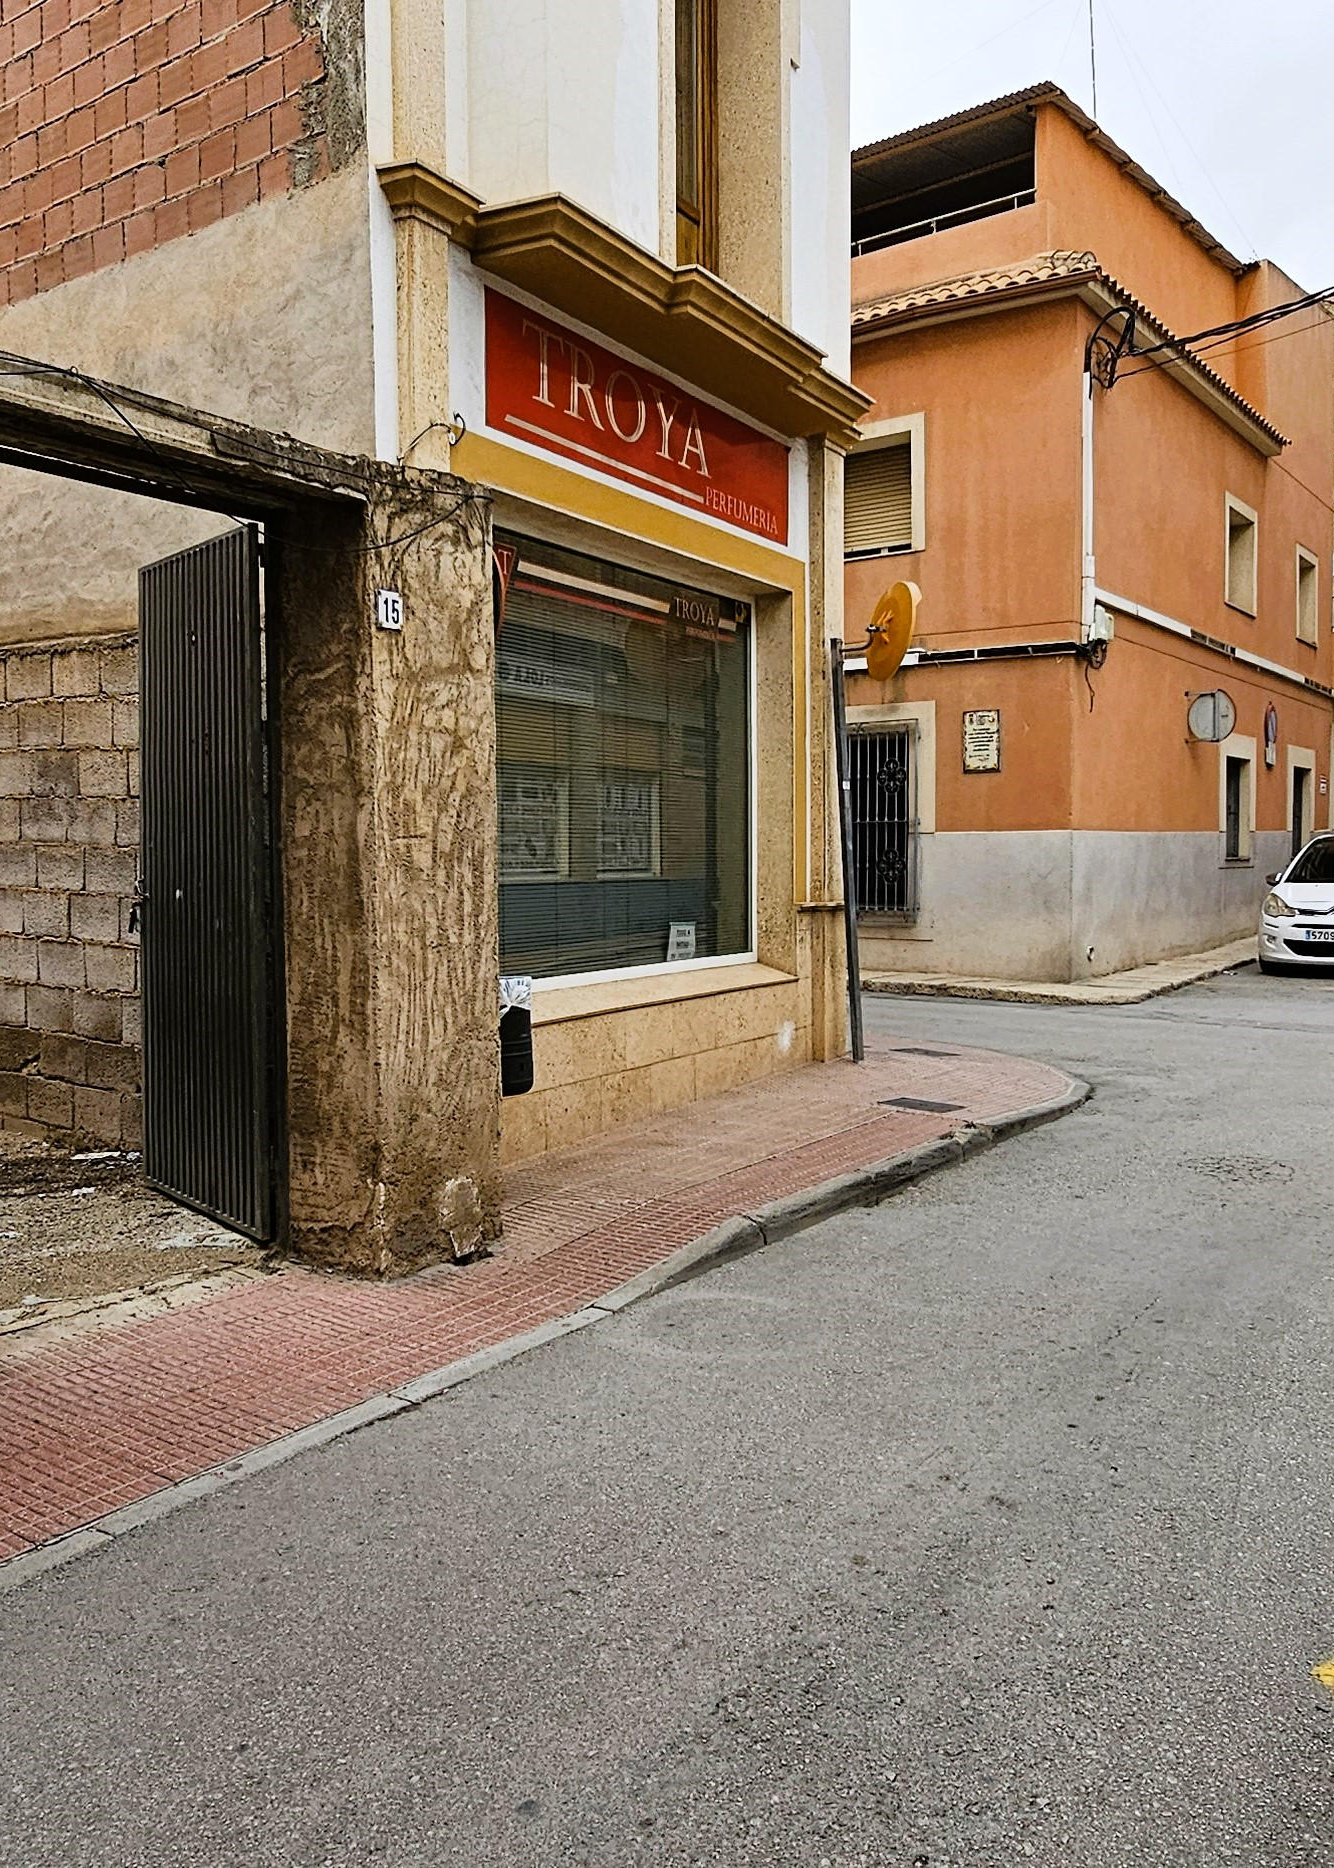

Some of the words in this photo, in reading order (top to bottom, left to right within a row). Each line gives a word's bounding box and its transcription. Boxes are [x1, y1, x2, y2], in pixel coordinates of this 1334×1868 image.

[523, 319, 711, 479] TROYA
[383, 597, 400, 624] 15
[673, 596, 715, 626] TROYA
